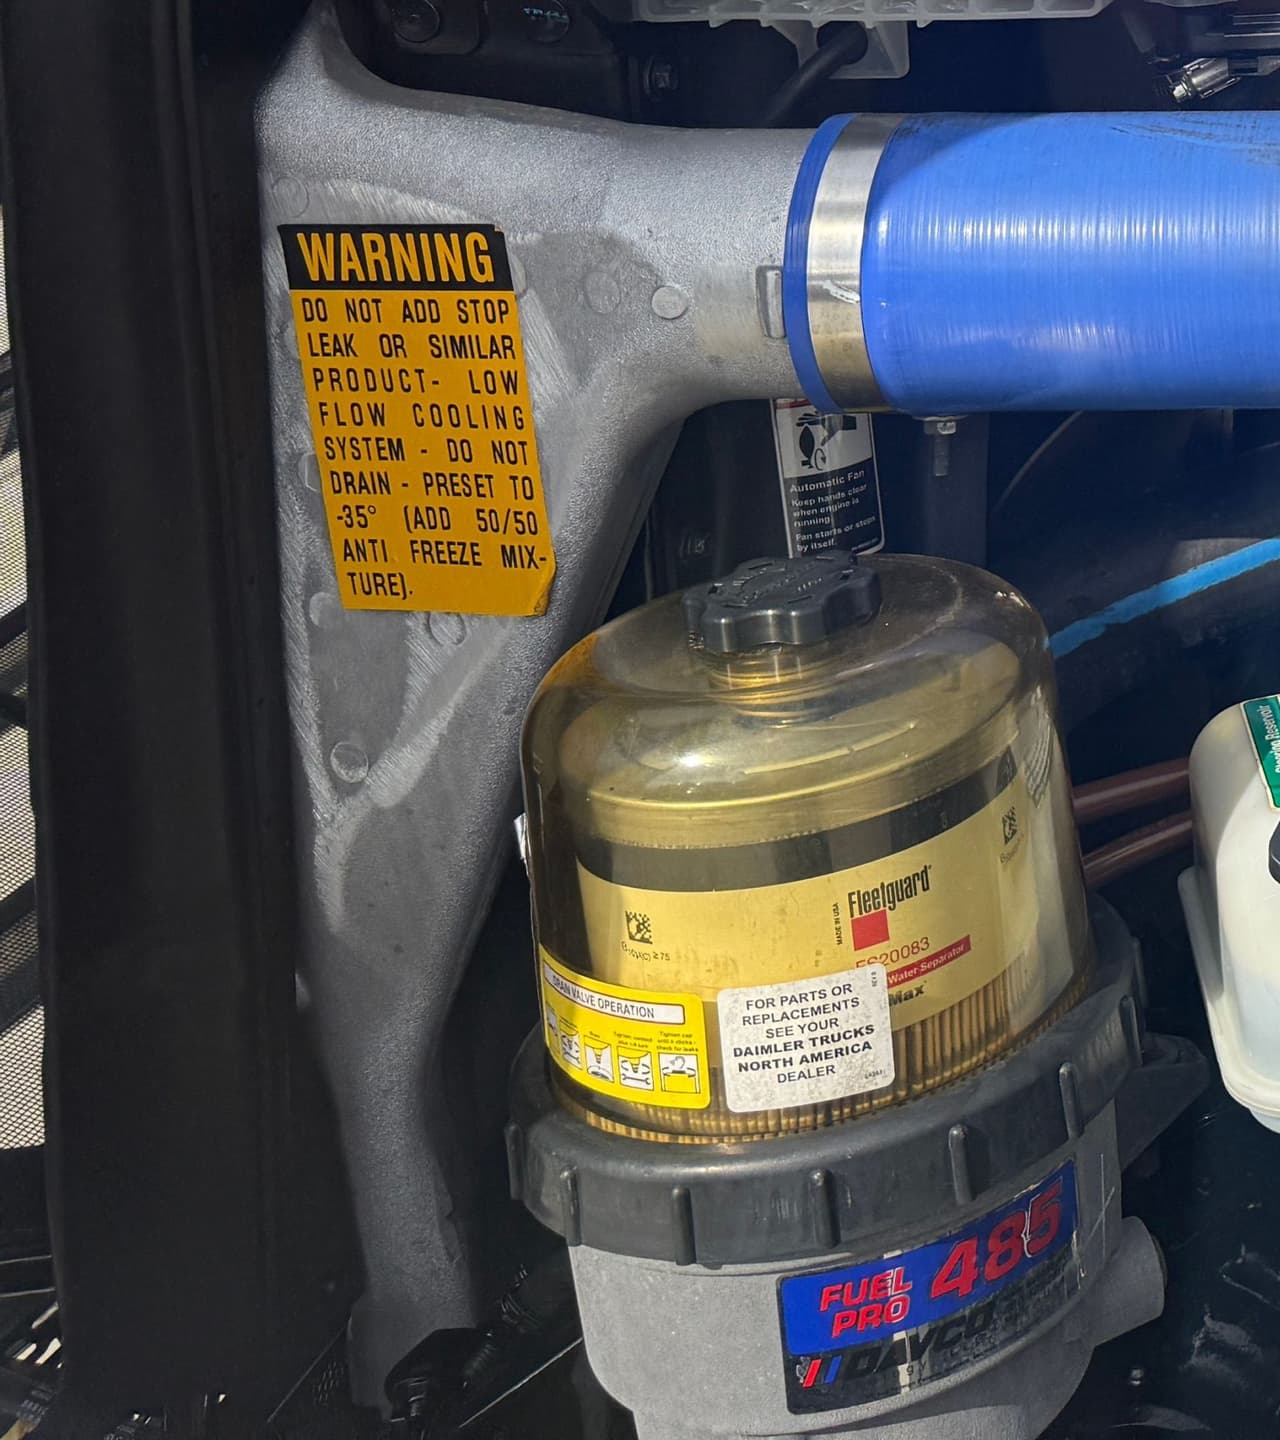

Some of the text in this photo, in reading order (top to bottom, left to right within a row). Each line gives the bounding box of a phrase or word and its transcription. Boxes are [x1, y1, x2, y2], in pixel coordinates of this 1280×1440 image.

[296, 231, 495, 284] WARNING
[302, 298, 510, 324] DO NOT ADD STOP
[307, 333, 516, 359] LEAK OR SIMILAR
[314, 367, 518, 395] PRODUCT- LOW
[320, 402, 525, 430] FLOW COOLING
[324, 437, 528, 465] SYSTEM DO NOT
[330, 470, 534, 500] DRAIN PRESET TO
[790, 470, 864, 493] Automatic Fan
[792, 496, 815, 507] Keep
[818, 491, 846, 503] hands
[793, 508, 817, 517] when
[820, 500, 850, 513] engine
[336, 505, 538, 536] -35° (ADD 50/50
[796, 532, 812, 541] Fan
[815, 527, 842, 538] starts
[844, 524, 853, 532] or
[343, 539, 547, 569] ANTI FREEZE MIX-
[797, 542, 808, 552] by
[348, 573, 413, 600] TURE).
[1257, 705, 1280, 740] Reservoir
[848, 865, 930, 918] Fleetguard
[920, 944, 965, 972] Separator
[571, 985, 595, 1007] VALVE
[598, 997, 654, 1019] OPERATION
[746, 983, 853, 1010] FOR PARTS OR
[742, 997, 860, 1027] REPLACEMENTS
[733, 1024, 874, 1057] DAIMLER TRUCKS
[765, 1020, 839, 1039] SEE YOUR
[738, 1040, 873, 1073] NORTH AMERICA
[778, 1064, 835, 1083] DEALER
[931, 1176, 1062, 1299] 485
[820, 1267, 912, 1311] FUEL
[832, 1295, 910, 1338] PRO
